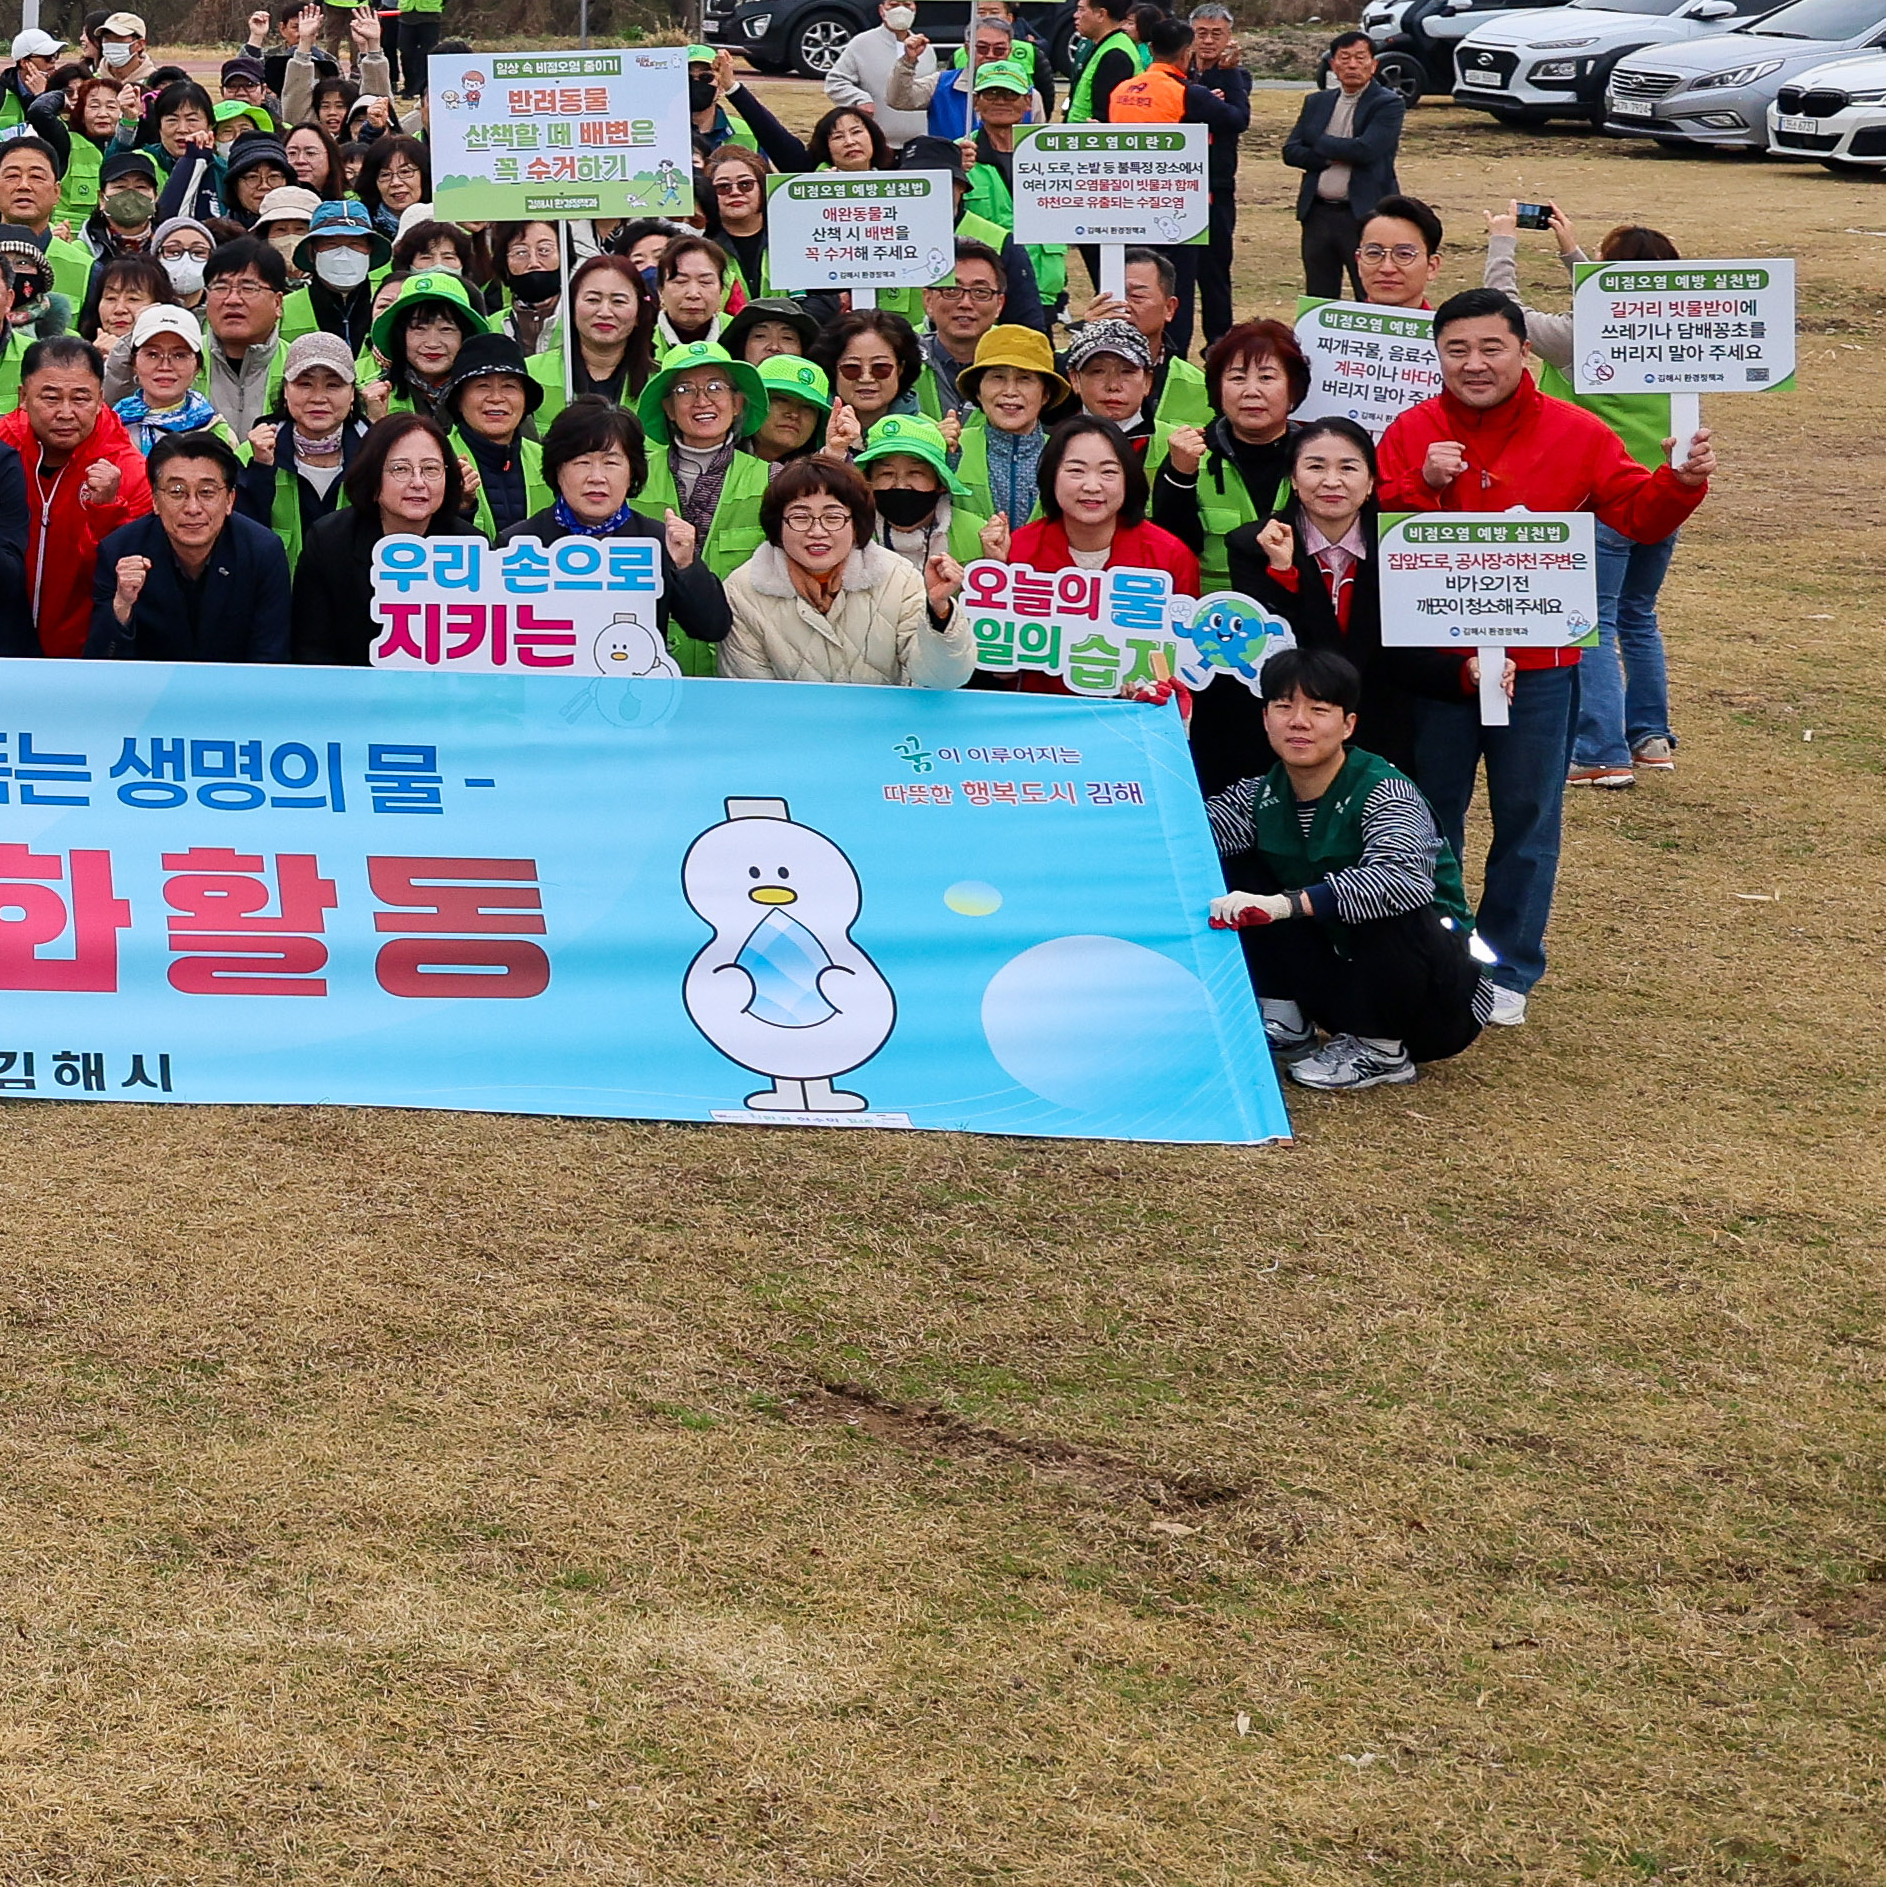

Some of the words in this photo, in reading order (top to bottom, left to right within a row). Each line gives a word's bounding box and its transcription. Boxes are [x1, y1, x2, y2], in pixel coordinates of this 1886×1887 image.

[508, 87, 610, 116] 반려동물
[464, 122, 540, 151] 산책할
[547, 122, 573, 148] 때
[579, 119, 657, 148] 배변은
[494, 157, 519, 184] 꼭
[526, 154, 628, 182] 수거하기
[1018, 162, 1045, 176] 도시,
[1046, 162, 1075, 176] 도로,
[1076, 162, 1101, 175] 논밭
[1102, 162, 1116, 175] 등
[1117, 162, 1154, 175] 불특정
[1155, 162, 1203, 175] 장소에서
[793, 184, 846, 198] 비점오염
[851, 184, 878, 196] 예방
[884, 182, 924, 196] 실천법
[1022, 179, 1047, 193] 여러
[1048, 179, 1073, 192] 가지
[1074, 179, 1135, 192] 오염물질이
[1136, 179, 1173, 192] 빗물과
[1174, 179, 1199, 192] 함께
[1037, 196, 1084, 210] 하천으로
[1086, 196, 1135, 209] 유출되는
[1136, 196, 1184, 209] 수질오염
[823, 206, 898, 222] 애완동물과
[811, 227, 841, 242] 산책
[846, 227, 860, 241] 시
[865, 225, 910, 241] 배변을
[805, 247, 820, 261] 꼭
[824, 246, 868, 261] 수거해
[873, 246, 918, 260] 주세요
[1605, 275, 1668, 290] 비점오염
[1674, 274, 1707, 290] 예방
[1713, 273, 1761, 289] 실천법
[1610, 300, 1662, 318] 길거리
[1668, 299, 1758, 317] 빗물받이에
[1325, 312, 1383, 333] 비점오염
[1389, 320, 1420, 337] 예방
[1601, 322, 1672, 340] 쓰레기나
[1677, 321, 1767, 339] 담배꽁초를
[1317, 337, 1385, 362] 찌개국물,
[1388, 345, 1437, 365] 음료수
[1610, 345, 1663, 363] 버리지
[1668, 344, 1704, 363] 말아
[1708, 344, 1763, 361] 주세요
[1334, 360, 1398, 382] 계곡이나
[1322, 380, 1369, 401] 버리지
[1373, 386, 1405, 405] 말아
[1409, 526, 1470, 541] 비점오염
[1477, 526, 1508, 541] 예방
[1514, 526, 1561, 541] 실천법
[379, 542, 480, 593] 우리
[501, 544, 656, 594] 손으로
[1446, 575, 1478, 593] 비가
[1479, 575, 1511, 593] 오기
[1513, 575, 1530, 593] 전
[965, 566, 1101, 621] 오늘의
[1109, 573, 1166, 630] 물
[1416, 598, 1464, 615] 깨끗이
[1466, 598, 1513, 615] 청소해
[1514, 598, 1563, 614] 주세요
[378, 603, 577, 668] 지키는
[967, 746, 1082, 764] 이루어지는
[110, 735, 346, 814] 생명의
[365, 743, 445, 815] 물
[883, 784, 952, 804] 따뜻한
[961, 780, 1077, 806] 행복도시
[1085, 782, 1144, 804] 김해
